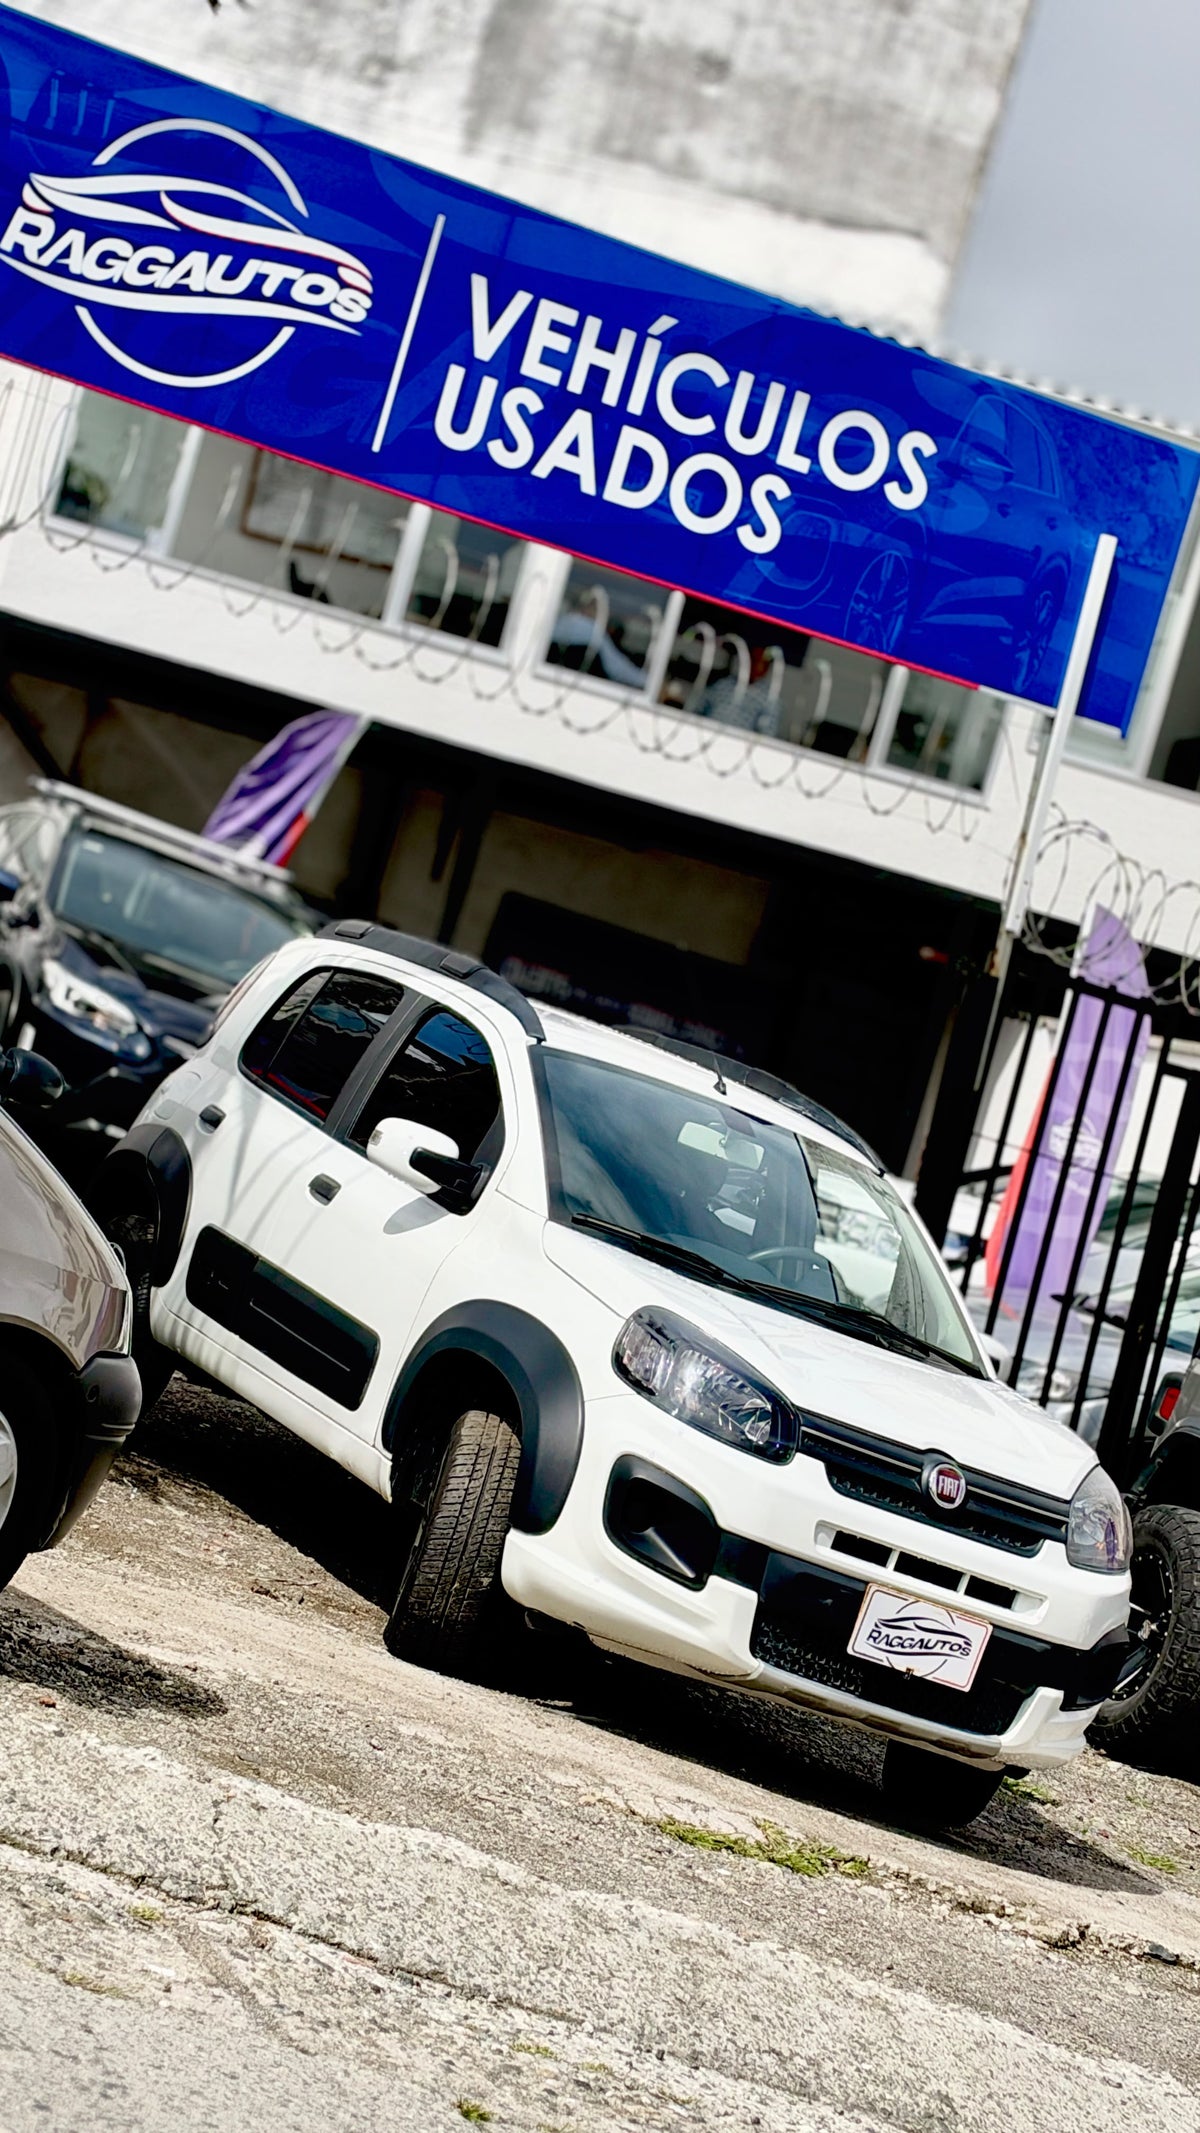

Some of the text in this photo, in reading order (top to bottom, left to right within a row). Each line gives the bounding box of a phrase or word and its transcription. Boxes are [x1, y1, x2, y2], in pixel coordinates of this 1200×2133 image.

[0, 206, 372, 322] RAGGAUTOS
[470, 273, 938, 511] VEHÍCULOS
[434, 363, 792, 554] USADOS
[937, 1475, 960, 1499] FIAT
[866, 1628, 972, 1657] RAGGAUTOS
